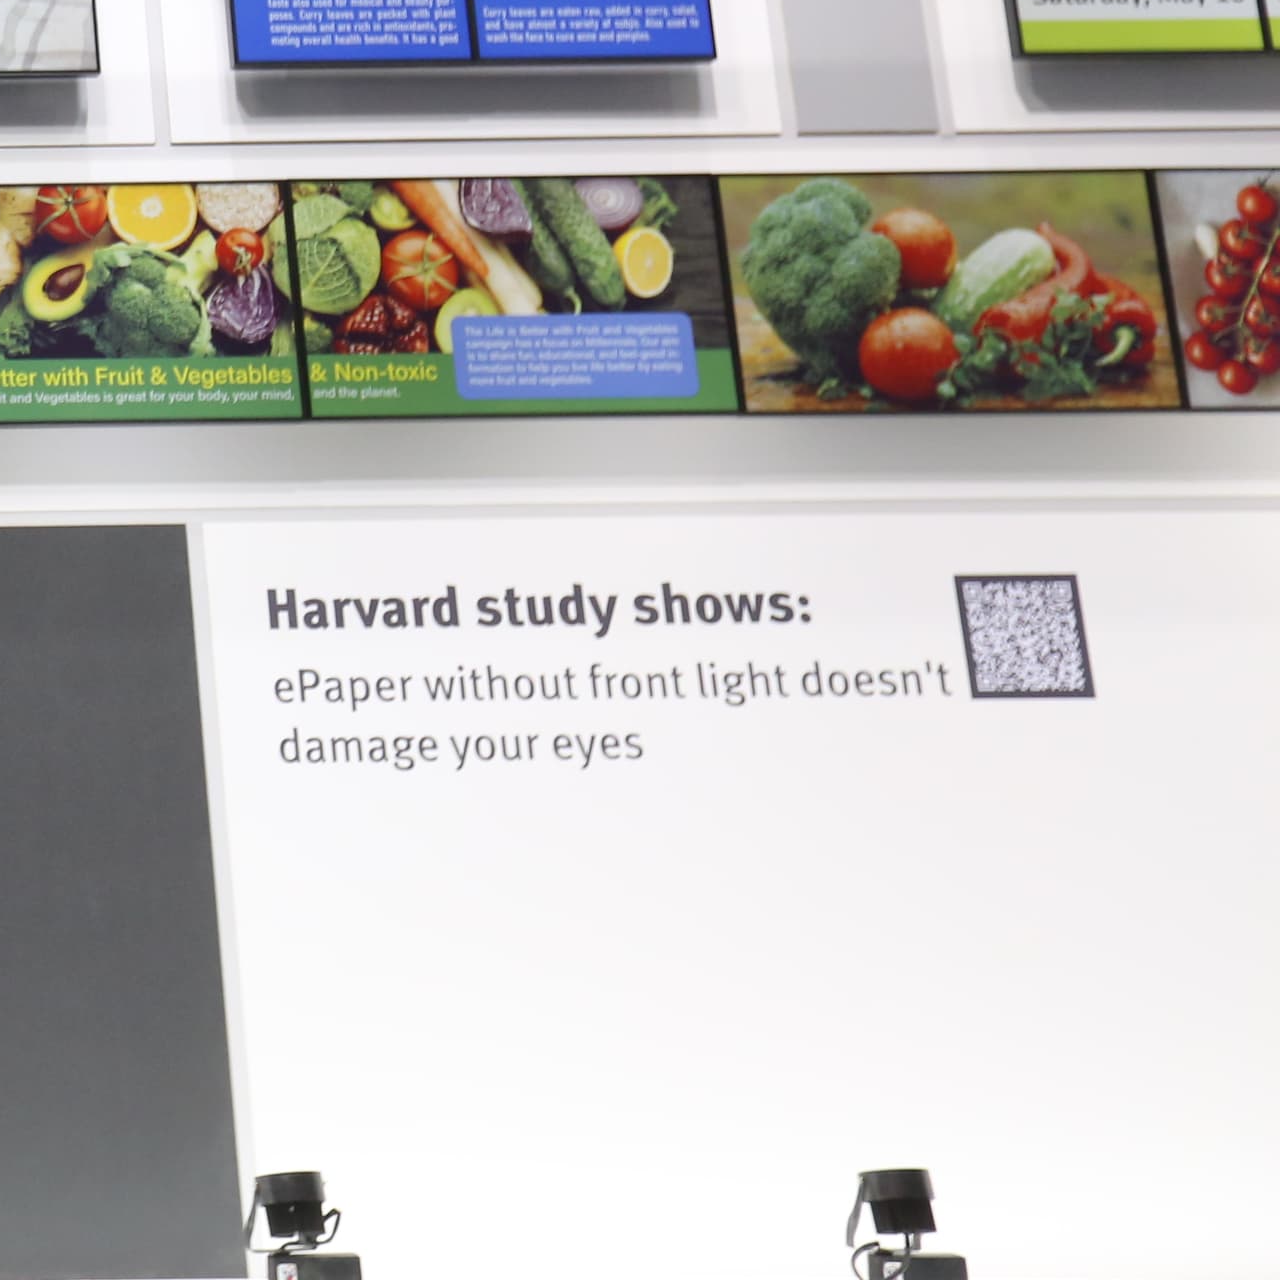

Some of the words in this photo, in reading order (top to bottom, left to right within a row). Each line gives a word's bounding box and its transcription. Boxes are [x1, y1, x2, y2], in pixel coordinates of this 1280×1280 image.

[44, 367, 88, 386] with
[95, 366, 144, 385] Fruit
[174, 364, 292, 389] Vegetables
[335, 362, 437, 381] Non-toxic
[267, 587, 459, 631] Harvard
[477, 586, 618, 637] study
[634, 585, 812, 626] shows:
[274, 668, 413, 711] ePaper
[424, 666, 578, 702] without
[590, 662, 685, 701] front
[697, 661, 789, 708] light
[801, 661, 952, 698] doesn't
[279, 729, 438, 771] damage
[449, 731, 539, 770] your
[552, 729, 644, 767] eyes
